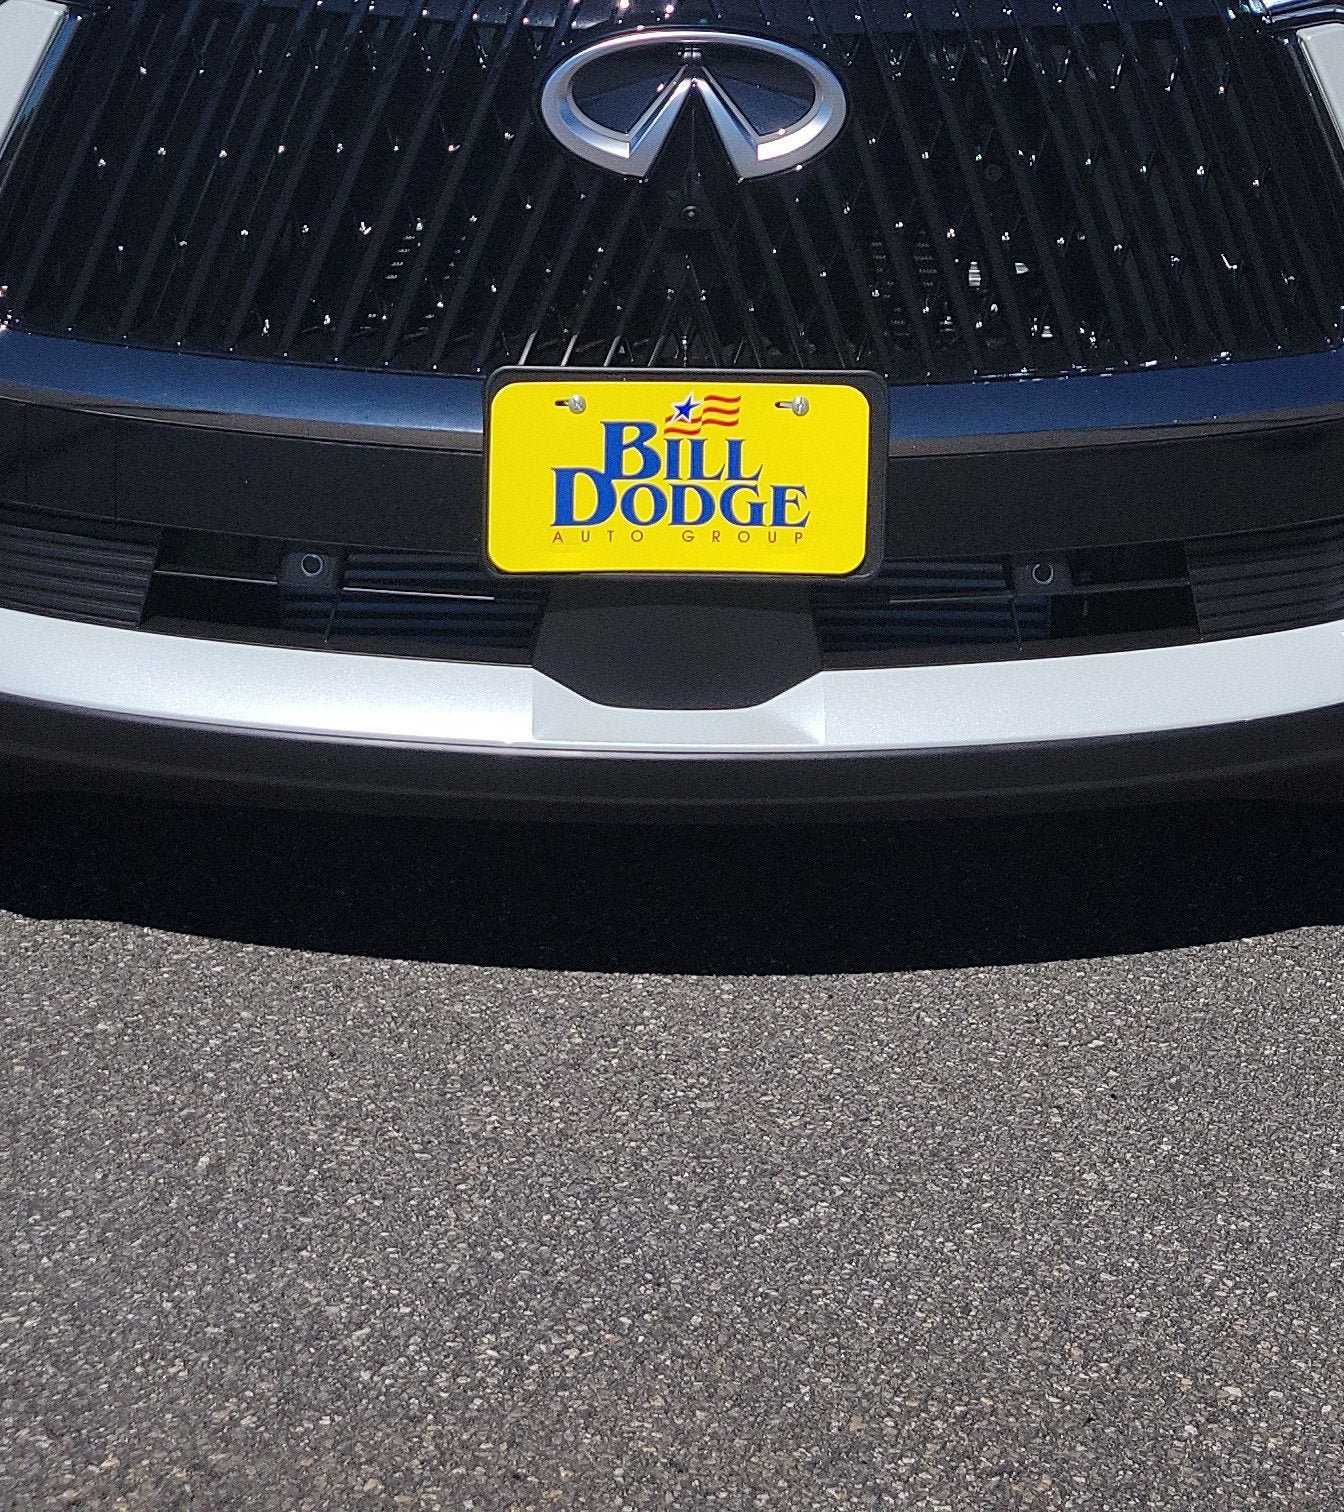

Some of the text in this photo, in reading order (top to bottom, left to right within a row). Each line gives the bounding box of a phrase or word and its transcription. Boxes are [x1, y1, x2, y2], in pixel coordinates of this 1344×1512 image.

[601, 420, 764, 481] BILL
[550, 466, 812, 528] DODGE
[552, 530, 804, 544] AUTO GROUP
